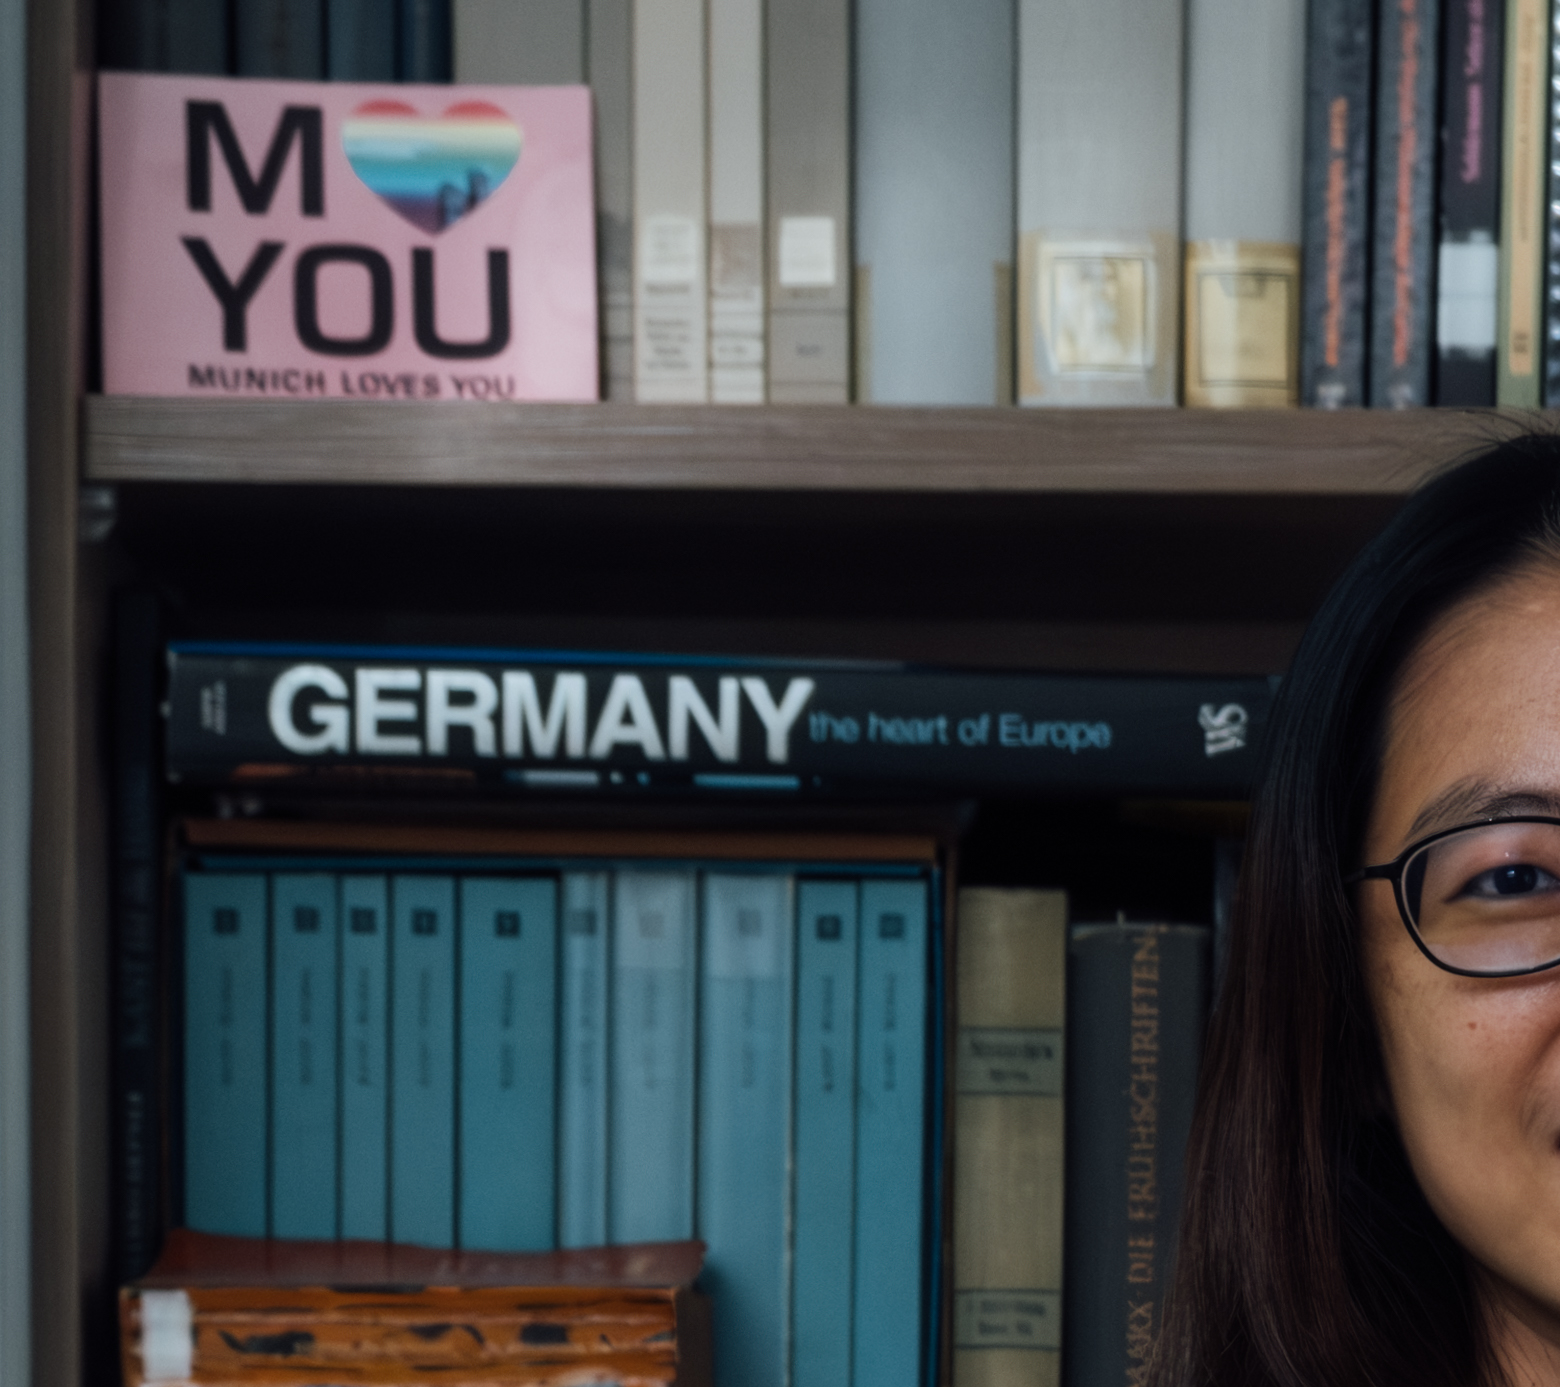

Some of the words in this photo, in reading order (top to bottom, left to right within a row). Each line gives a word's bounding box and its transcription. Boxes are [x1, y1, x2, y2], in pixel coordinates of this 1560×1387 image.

[183, 98, 324, 217] M
[178, 239, 513, 359] YOU
[188, 364, 326, 397] MUNICH
[341, 369, 439, 399] LOVES
[449, 374, 515, 400] YOU
[267, 664, 814, 763] GERMANY
[811, 711, 860, 745] the
[871, 712, 949, 748] heart
[955, 714, 991, 748] of
[997, 715, 1111, 754] Europe
[1128, 1238, 1154, 1283] DIE
